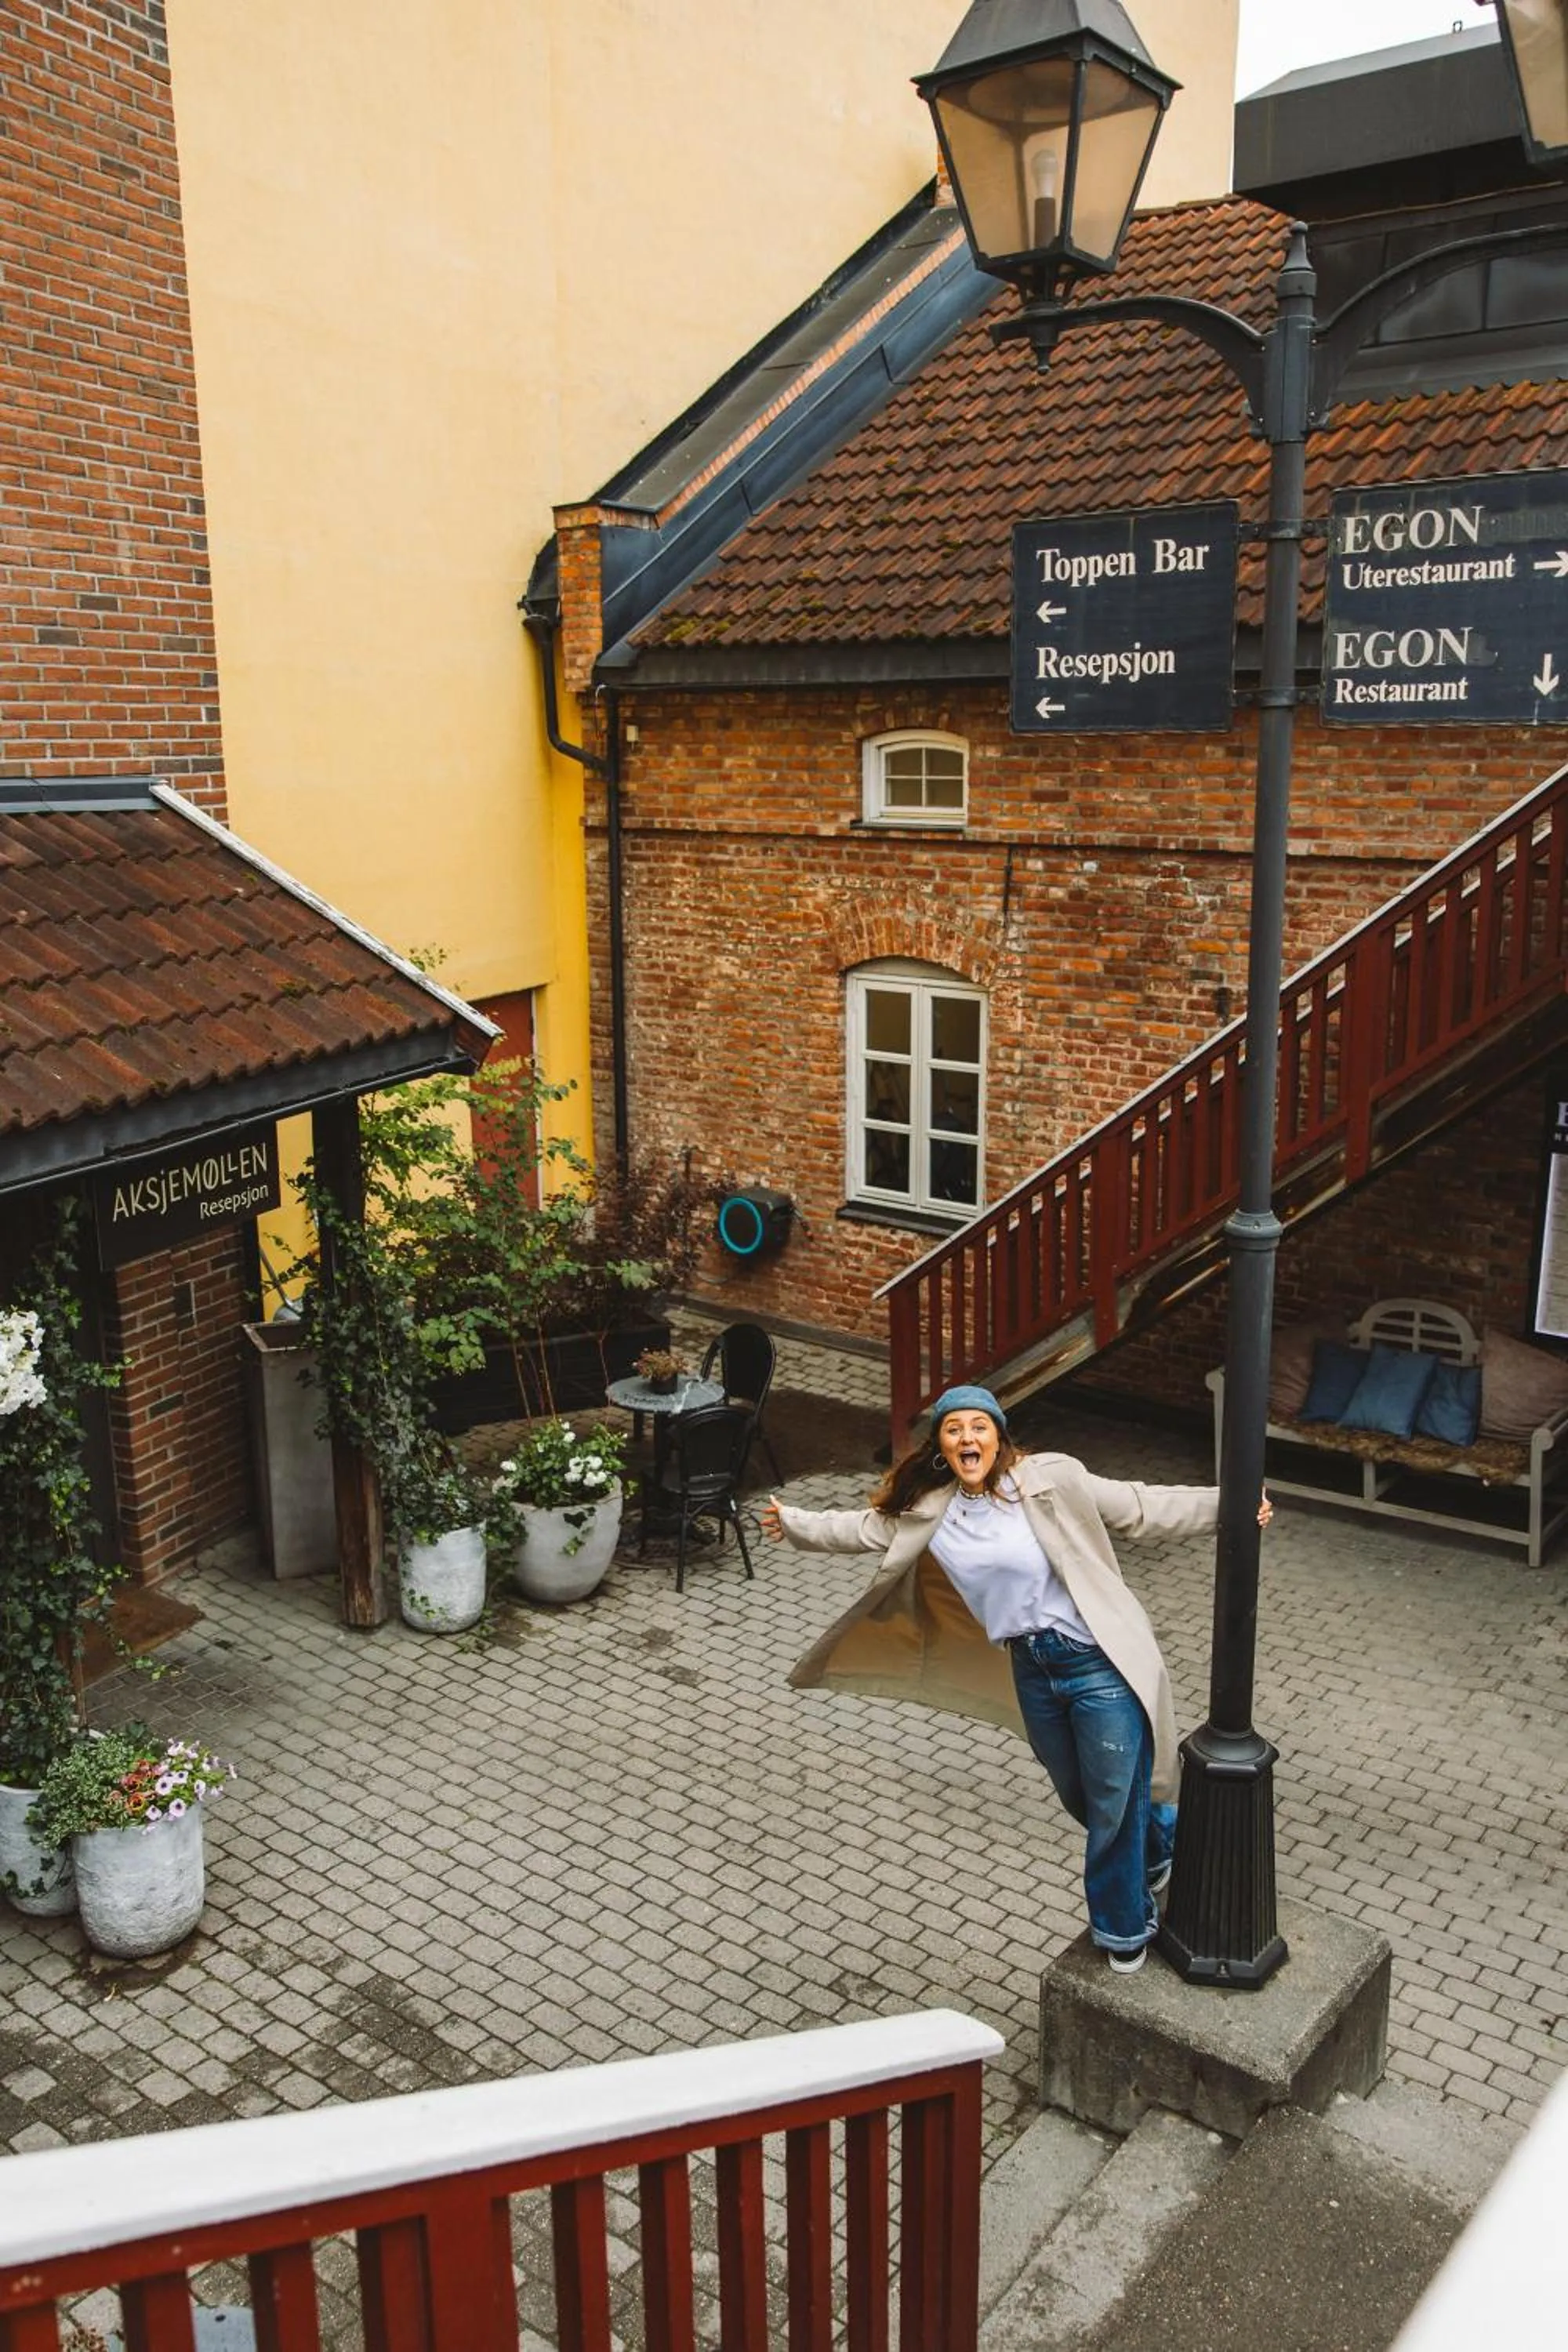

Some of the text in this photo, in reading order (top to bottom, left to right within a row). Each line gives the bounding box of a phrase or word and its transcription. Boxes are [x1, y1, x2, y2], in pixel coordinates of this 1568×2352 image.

[1341, 506, 1486, 555] EGON
[1036, 539, 1210, 588] Toppen Bar
[1342, 552, 1516, 590] Uterestaurant
[1035, 641, 1176, 684] Resepsjon
[1331, 626, 1474, 670] EGON
[1334, 677, 1468, 704] Restaurant
[200, 1185, 270, 1220] Resepsjon
